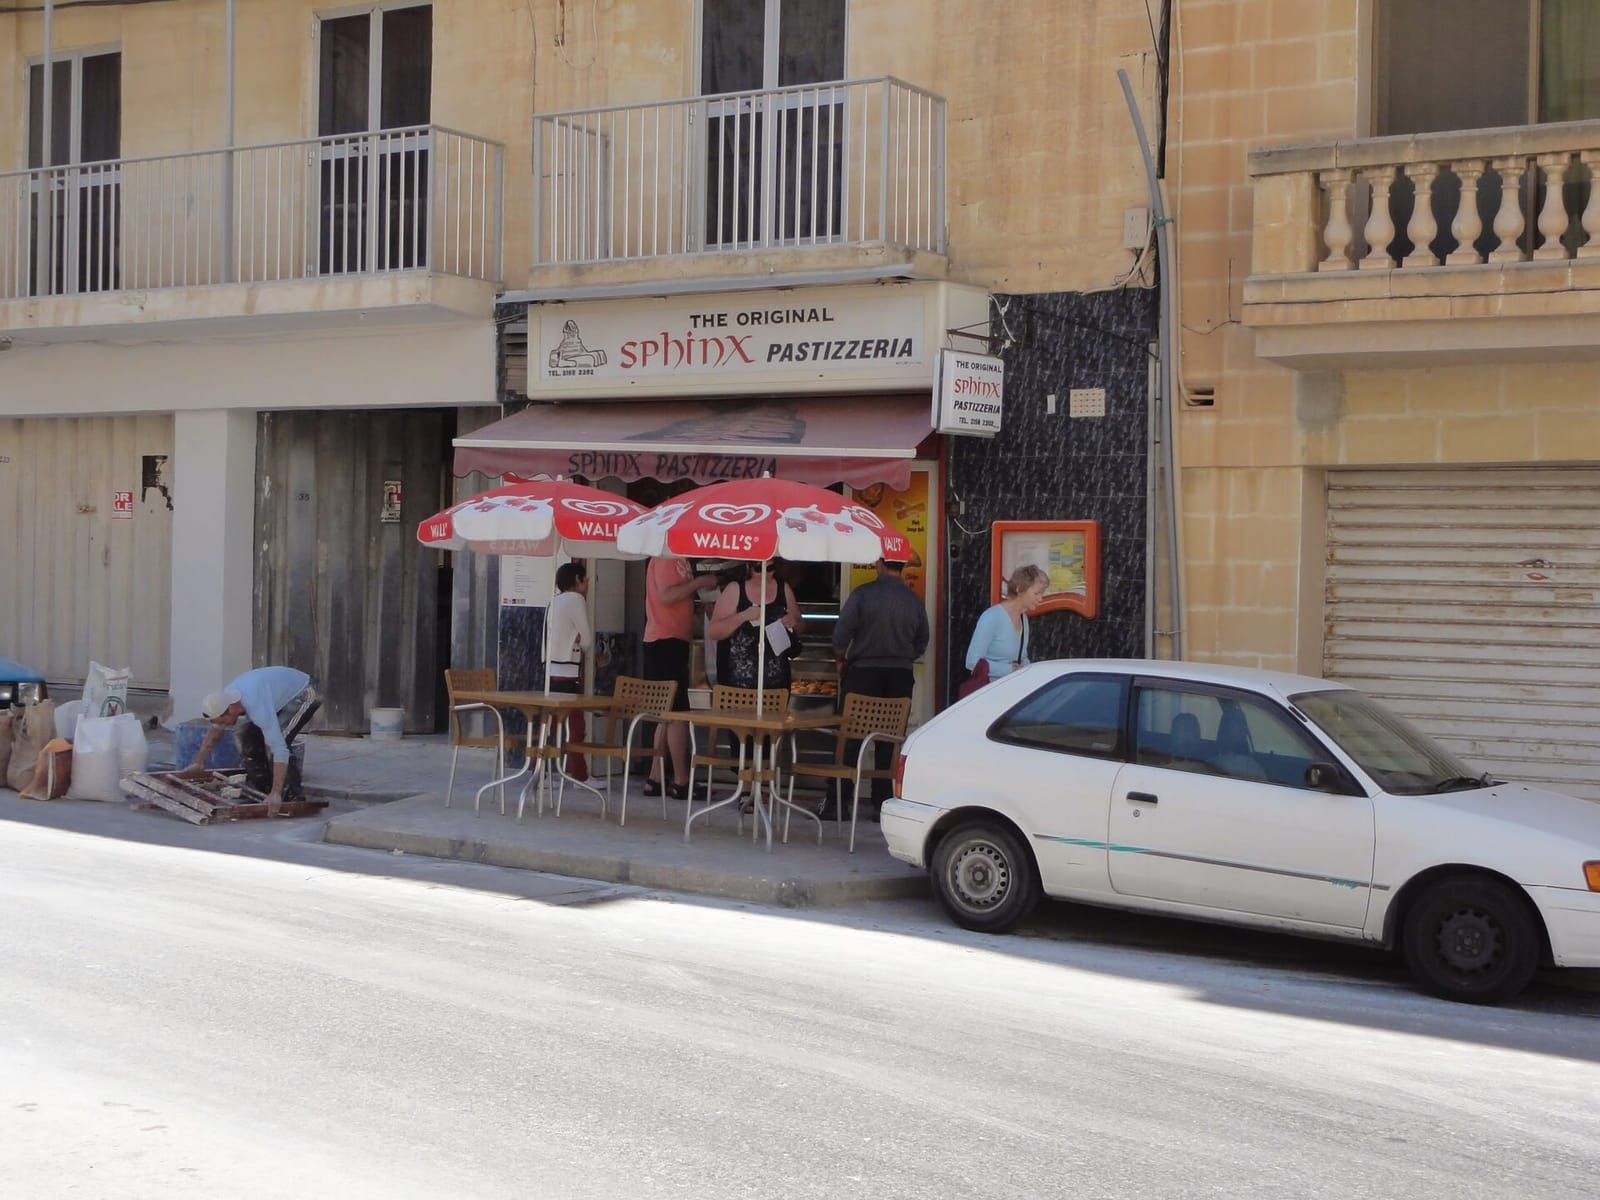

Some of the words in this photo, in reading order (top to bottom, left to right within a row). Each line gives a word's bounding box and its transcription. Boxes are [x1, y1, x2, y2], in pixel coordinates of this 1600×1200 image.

[690, 313, 728, 329] THE
[736, 307, 834, 327] ORIGINAL
[766, 337, 913, 363] PASTIZZERIA
[956, 360, 969, 369] THE
[970, 362, 1002, 374] ORIGINAL
[953, 400, 1000, 415] PASTIZZERIA
[656, 453, 777, 478] PASTIZZERIA
[693, 532, 753, 550] WALL'S
